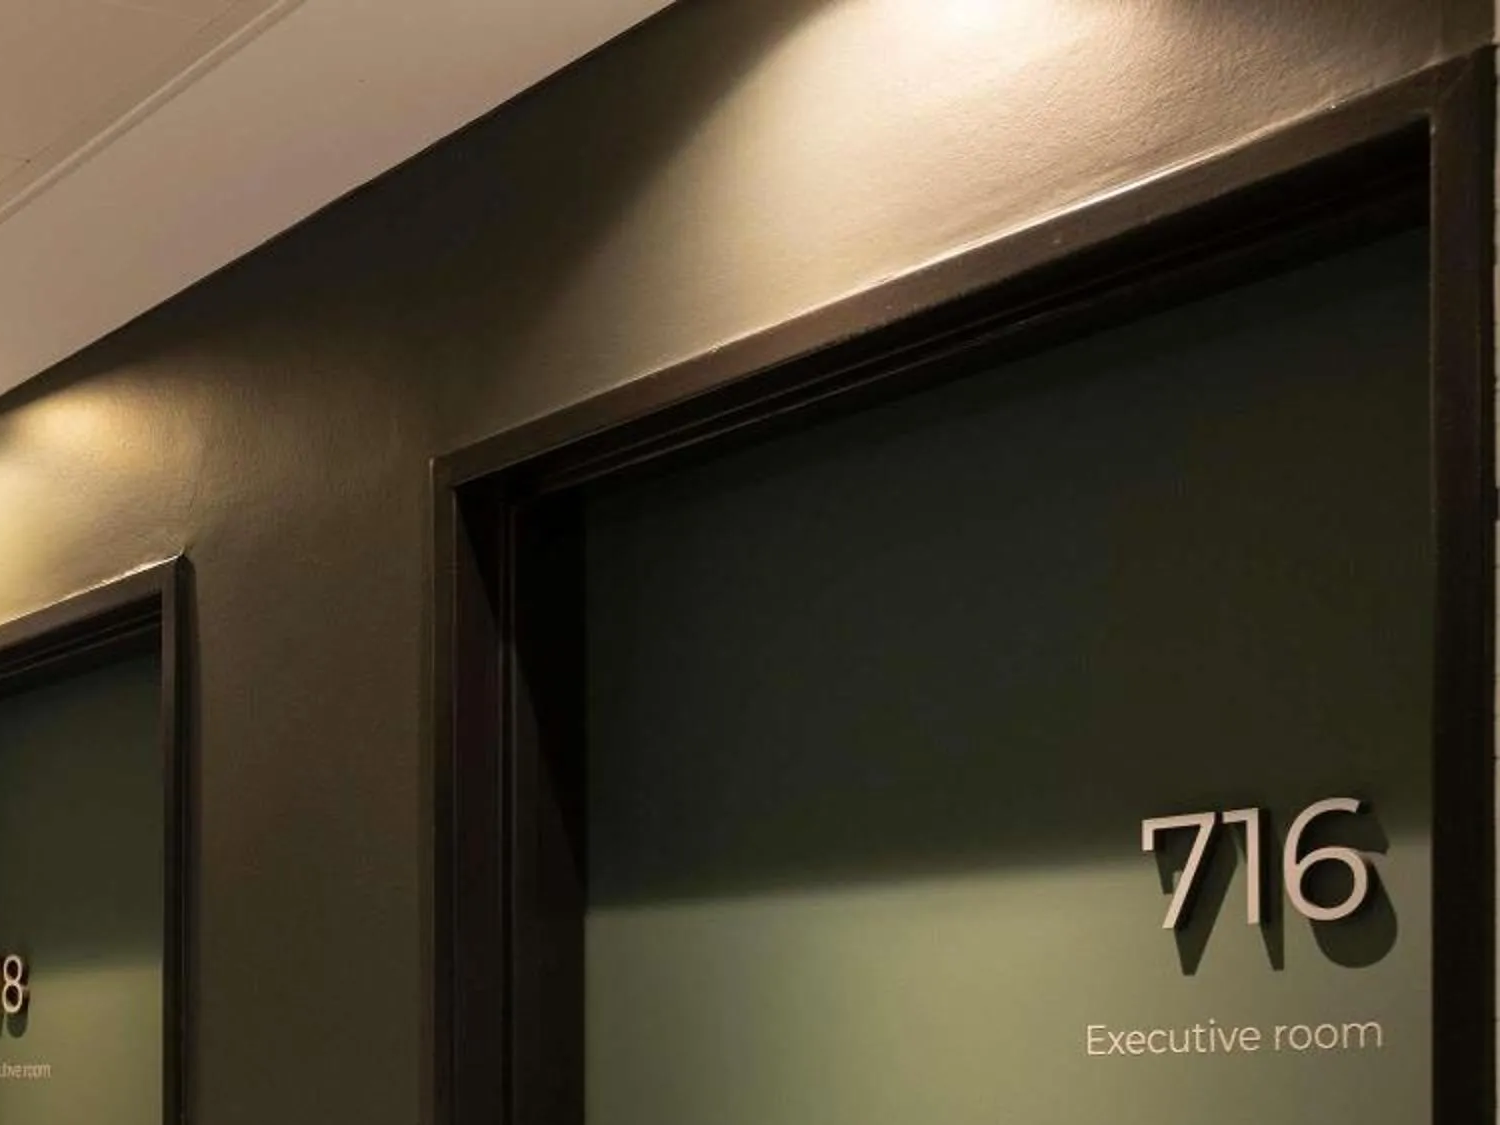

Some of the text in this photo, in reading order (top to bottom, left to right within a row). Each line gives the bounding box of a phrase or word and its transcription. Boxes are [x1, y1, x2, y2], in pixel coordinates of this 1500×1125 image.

[1142, 798, 1369, 929] 716
[1087, 1018, 1384, 1056] Executive room
